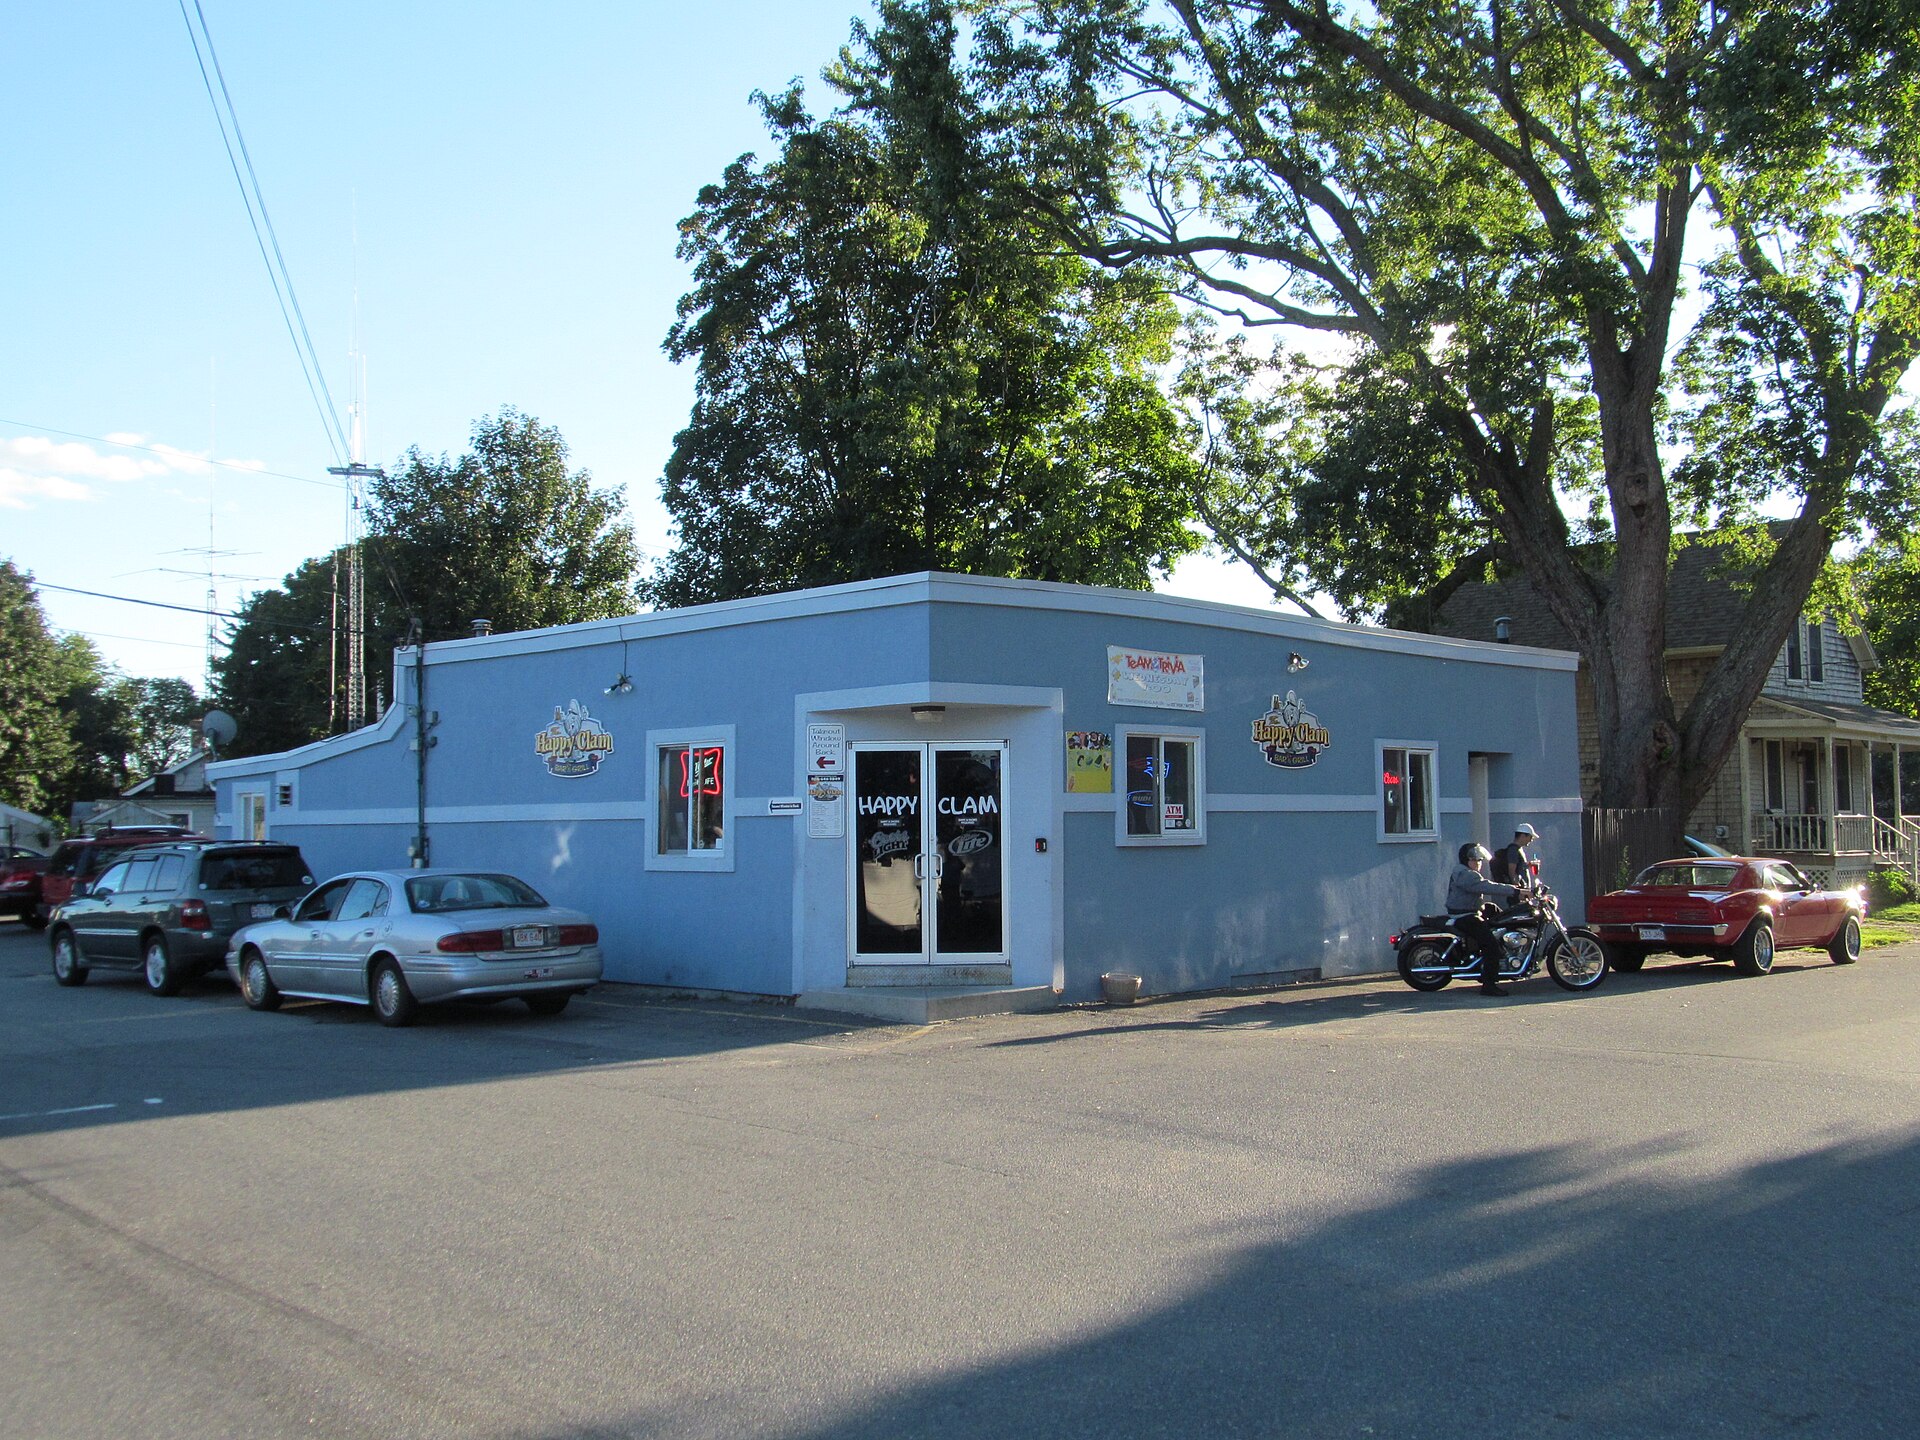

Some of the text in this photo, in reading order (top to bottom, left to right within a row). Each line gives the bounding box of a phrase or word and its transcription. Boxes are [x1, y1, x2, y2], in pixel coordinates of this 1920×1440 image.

[536, 729, 613, 758] Happy Clam
[1253, 720, 1330, 748] Happy Clam
[858, 794, 998, 815] HAPPY CLAM
[1165, 805, 1182, 814] ATM
[957, 837, 987, 854] Lite
